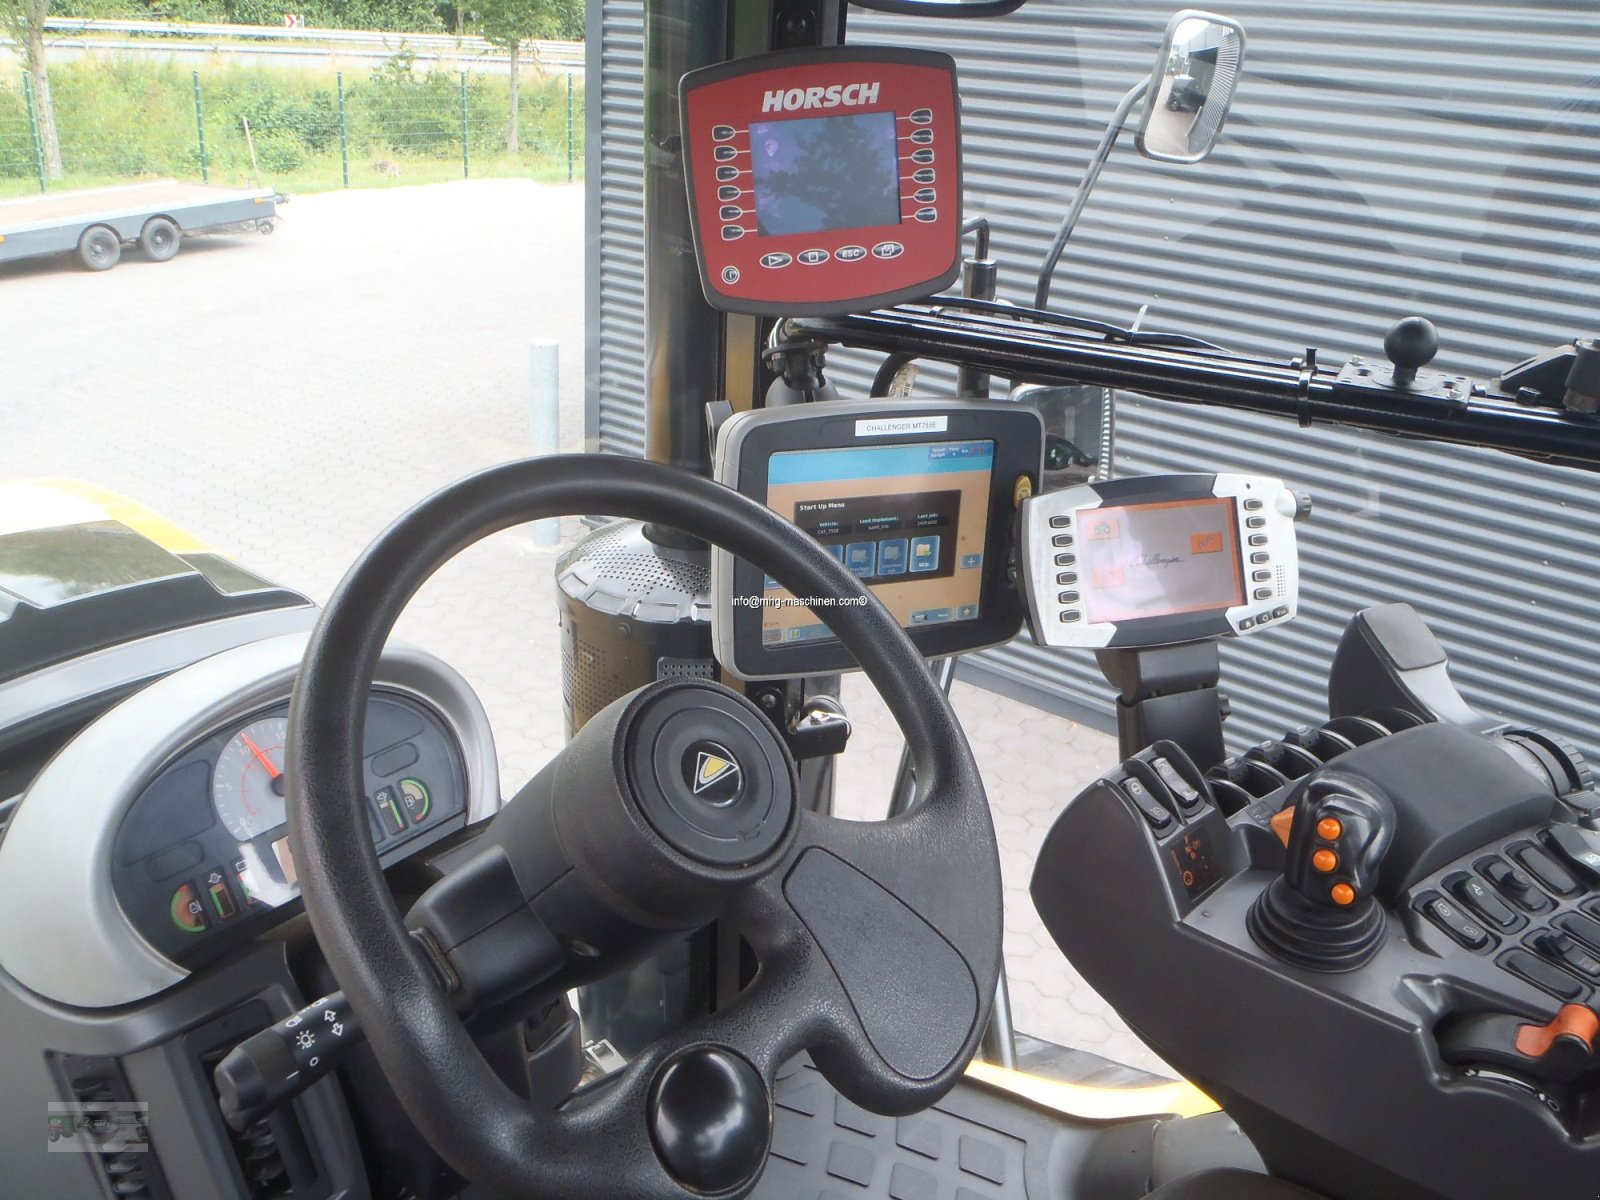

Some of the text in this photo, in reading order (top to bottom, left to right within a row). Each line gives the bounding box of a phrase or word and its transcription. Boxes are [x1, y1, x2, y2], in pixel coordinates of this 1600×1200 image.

[761, 82, 880, 113] HORSCH
[842, 248, 860, 259] ESC
[866, 423, 911, 432] CHALLENGER
[799, 501, 845, 511] Start Up Menu
